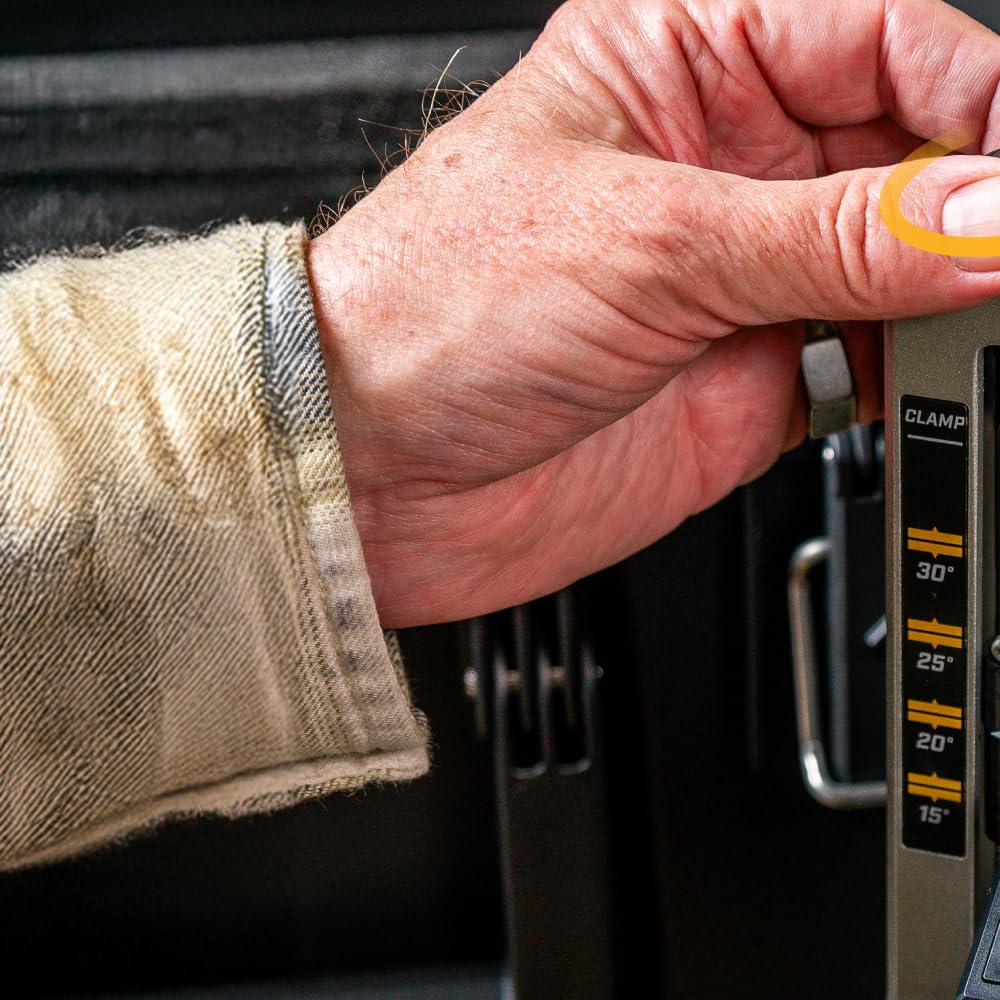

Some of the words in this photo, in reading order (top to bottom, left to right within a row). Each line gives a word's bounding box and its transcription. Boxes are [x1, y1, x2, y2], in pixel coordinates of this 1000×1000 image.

[905, 408, 966, 430] CLAMP
[915, 561, 955, 583] 30°
[916, 652, 954, 672] 25°
[916, 732, 954, 753] 20°
[919, 805, 950, 825] 15°
